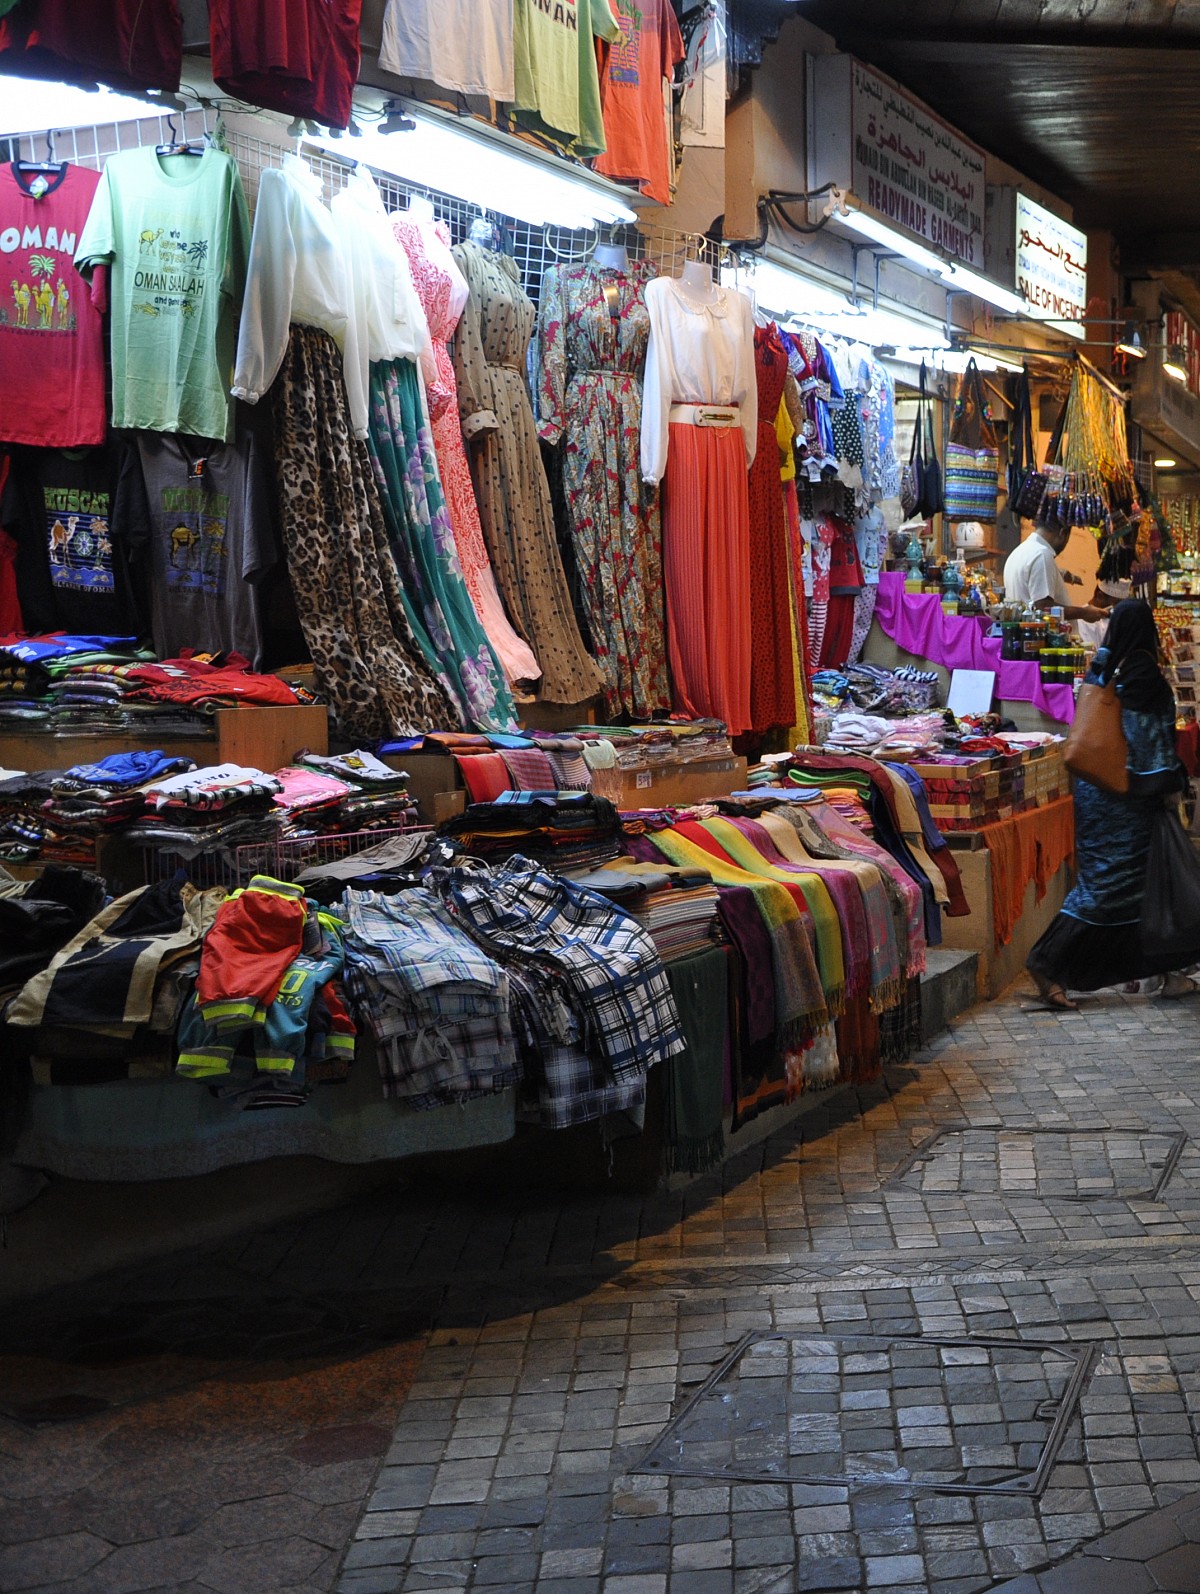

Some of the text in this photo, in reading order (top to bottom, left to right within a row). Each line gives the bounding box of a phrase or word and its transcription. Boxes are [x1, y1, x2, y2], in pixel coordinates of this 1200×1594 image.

[532, 0, 577, 31] MAN
[867, 114, 974, 202] الملابس الجاهزة
[868, 176, 927, 236] READYMADE
[931, 213, 974, 262] GARMENTS
[0, 225, 76, 256] OMAN
[134, 271, 168, 291] OMAN
[1018, 276, 1041, 307] SALE
[1041, 288, 1052, 313] OF
